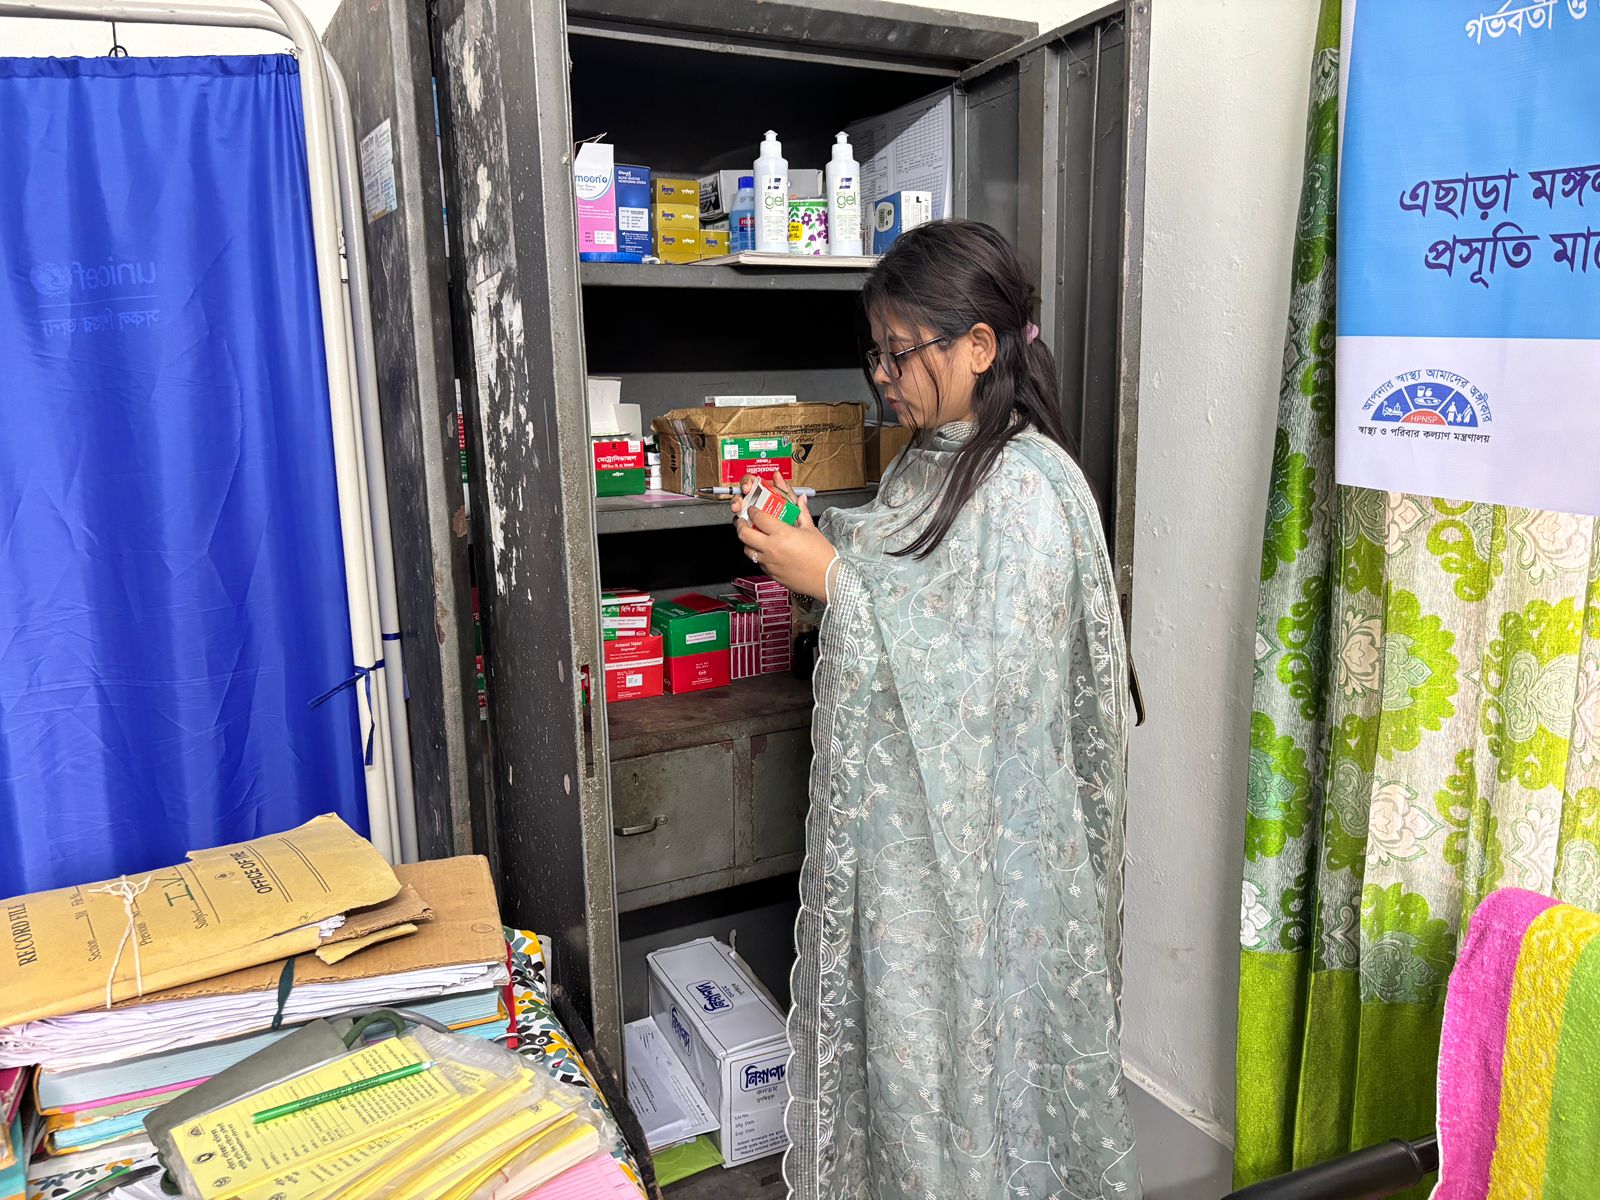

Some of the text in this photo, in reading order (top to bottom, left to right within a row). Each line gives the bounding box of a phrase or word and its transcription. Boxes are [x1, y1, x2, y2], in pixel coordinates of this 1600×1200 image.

[764, 193, 785, 209] gel
[836, 192, 857, 208] gel
[1400, 168, 1519, 220] এছাড়া
[1424, 222, 1541, 289] প্রসূতি
[1361, 379, 1394, 411] আপনার
[1425, 368, 1470, 388] আমাদের
[1410, 415, 1438, 423] HPNSP
[1358, 425, 1377, 436] স্বাস্থ্য
[1380, 428, 1387, 436] ও
[1390, 427, 1420, 439] পরিবার
[1423, 431, 1451, 441] কল্যাণ
[237, 859, 255, 869] OF
[245, 868, 273, 894] OFFICE
[7, 903, 38, 967] RECORD FILE
